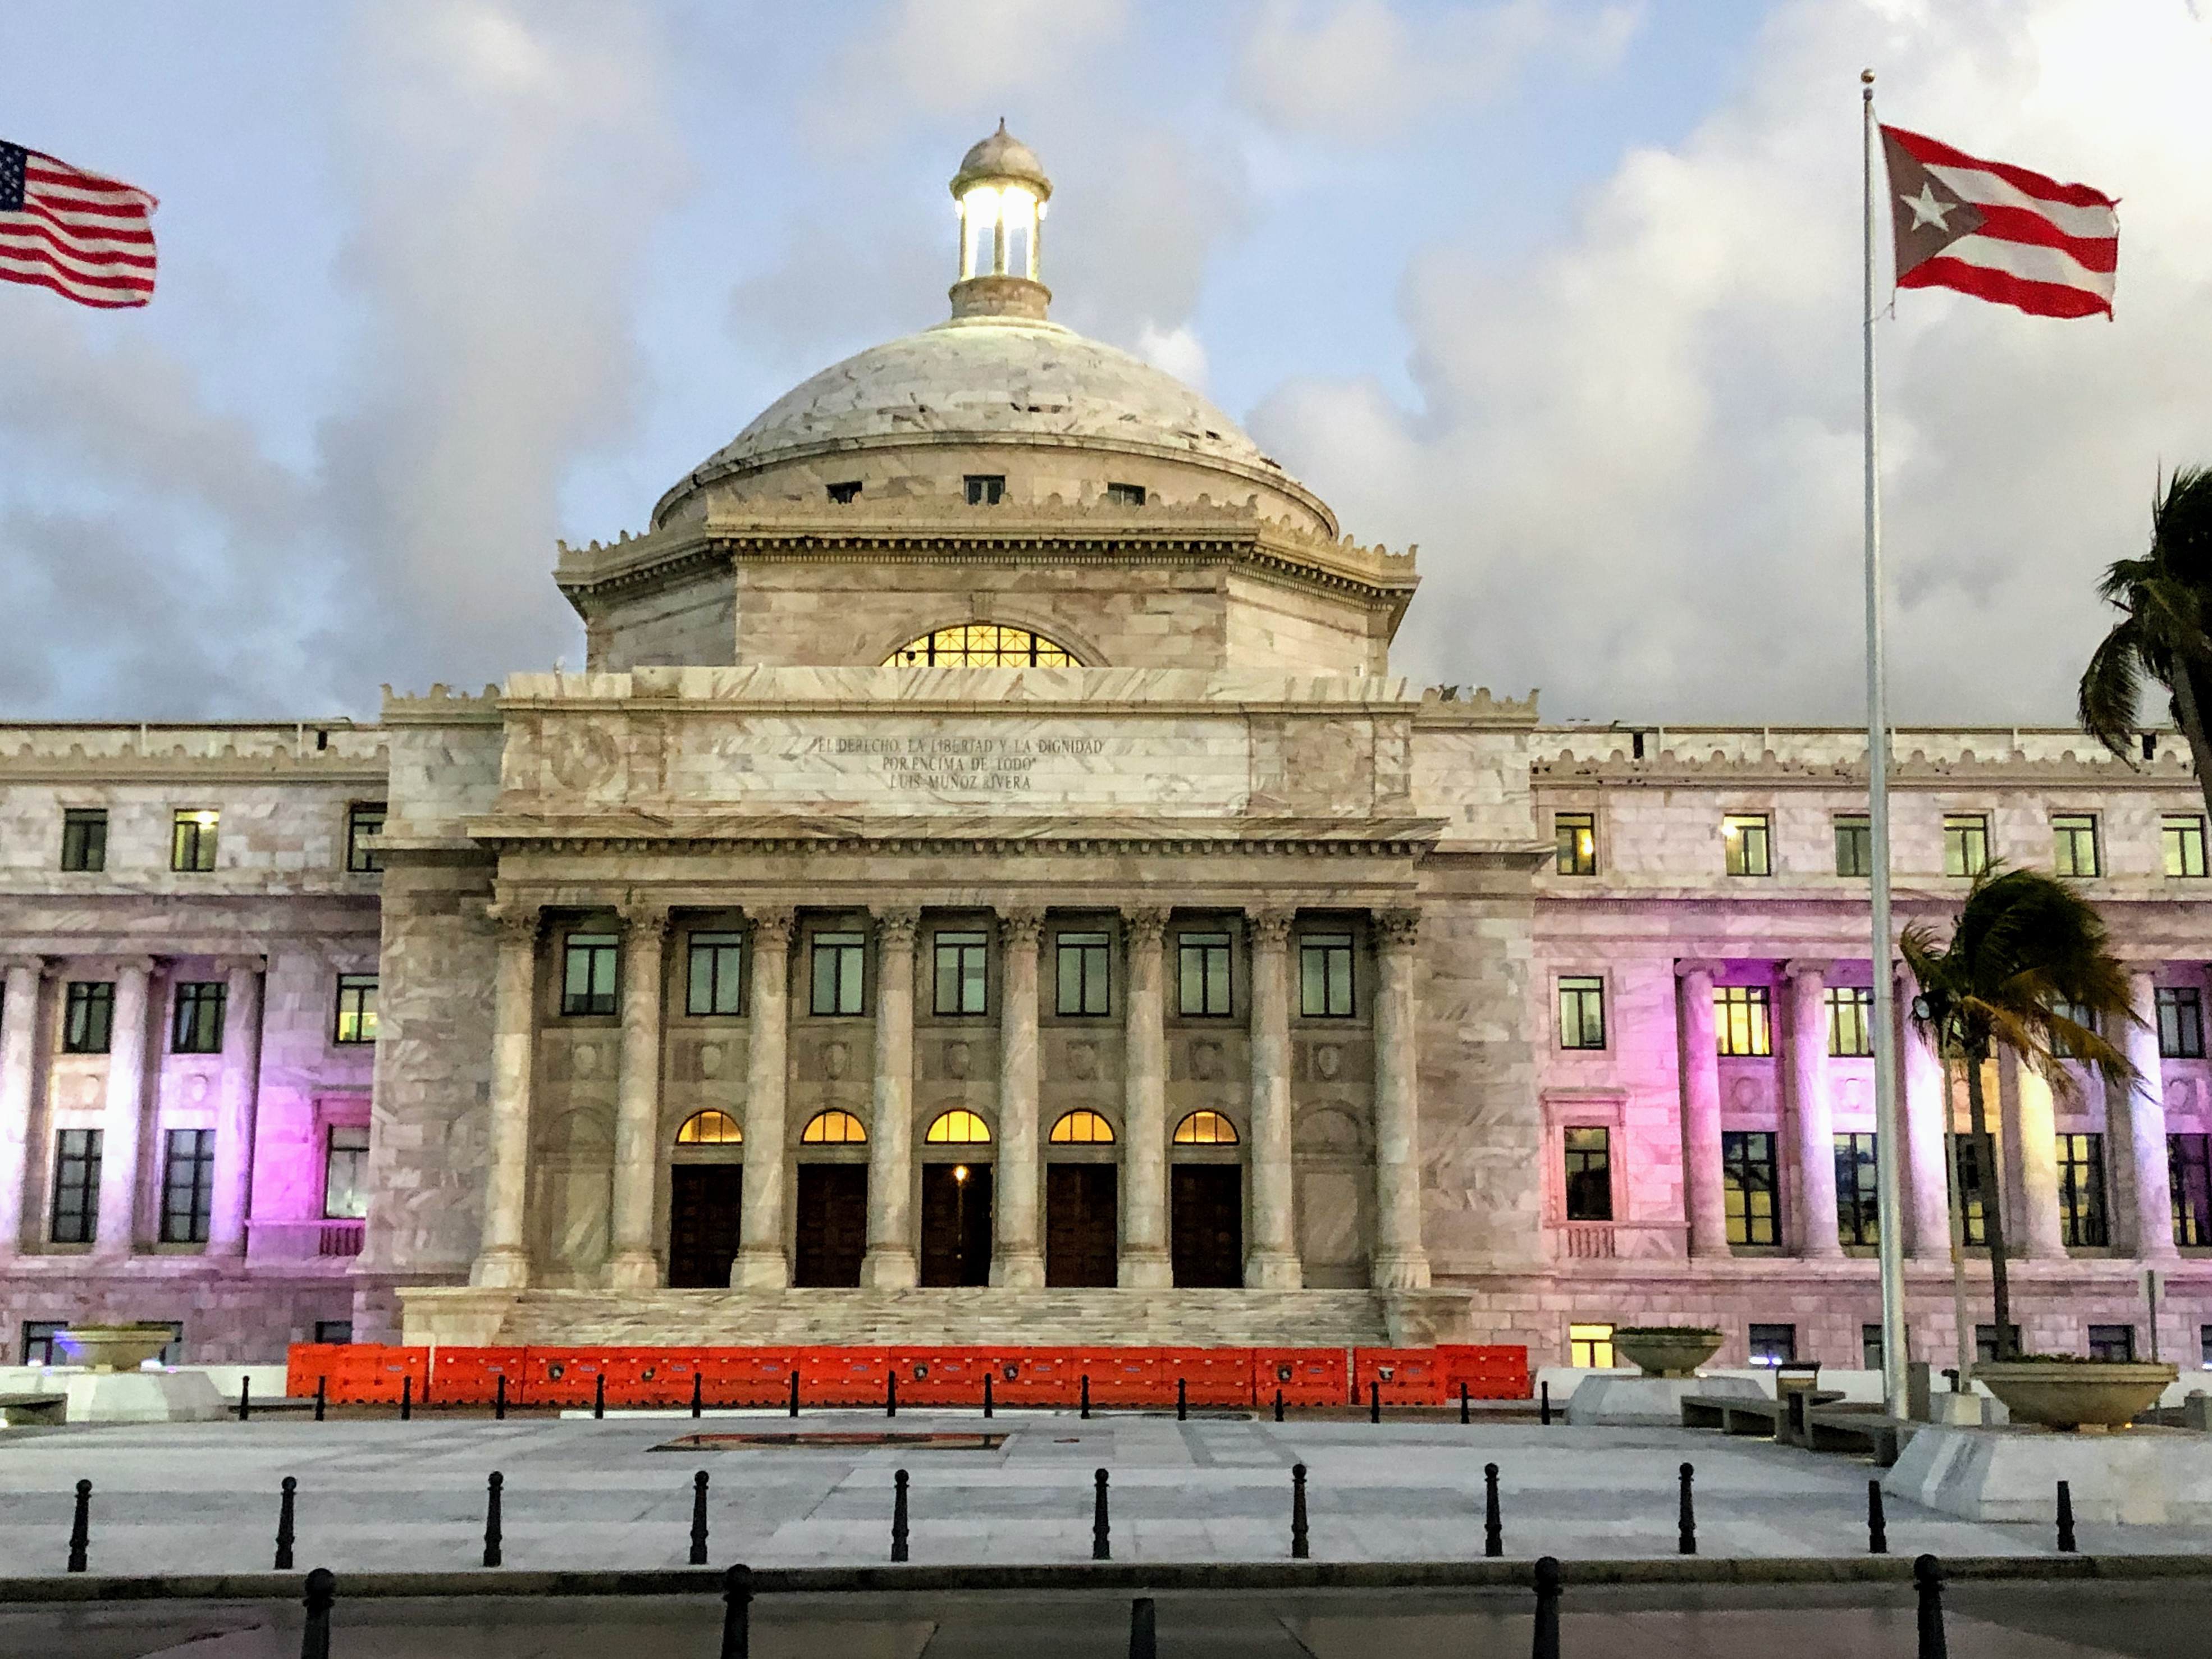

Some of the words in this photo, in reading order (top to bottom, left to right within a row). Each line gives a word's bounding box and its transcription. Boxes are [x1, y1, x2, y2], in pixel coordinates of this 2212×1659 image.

[908, 739, 924, 753] LA
[931, 738, 993, 753] LIBERTAD
[1000, 739, 1007, 753] Y
[1015, 740, 1031, 753] LA
[1038, 739, 1103, 753] DIGNIDAD
[883, 757, 907, 771] POR
[912, 757, 964, 771] ENCIMA
[971, 757, 987, 771] DE
[890, 775, 921, 789] LUIS
[982, 774, 1031, 789] RIVERA
